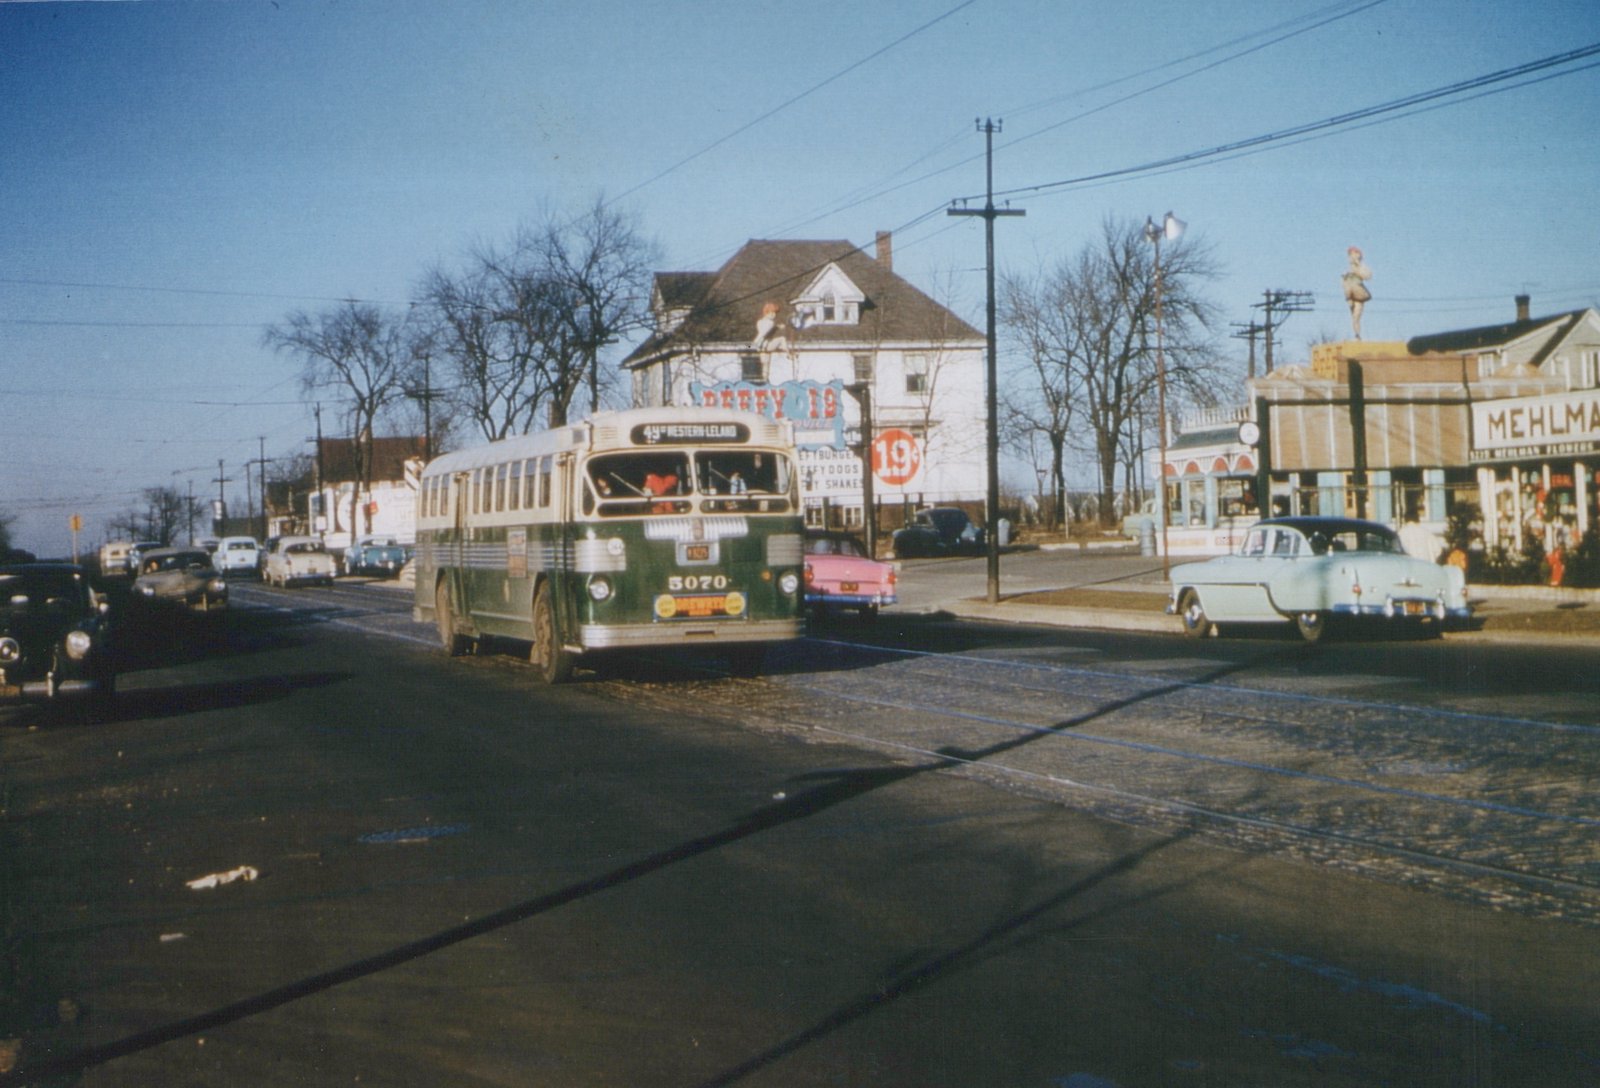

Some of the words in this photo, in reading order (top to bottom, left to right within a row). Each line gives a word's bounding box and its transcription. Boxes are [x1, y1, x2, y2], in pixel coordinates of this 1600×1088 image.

[809, 388, 836, 418] 19
[1488, 401, 1600, 440] MEHLMA
[668, 575, 727, 591] 5070
